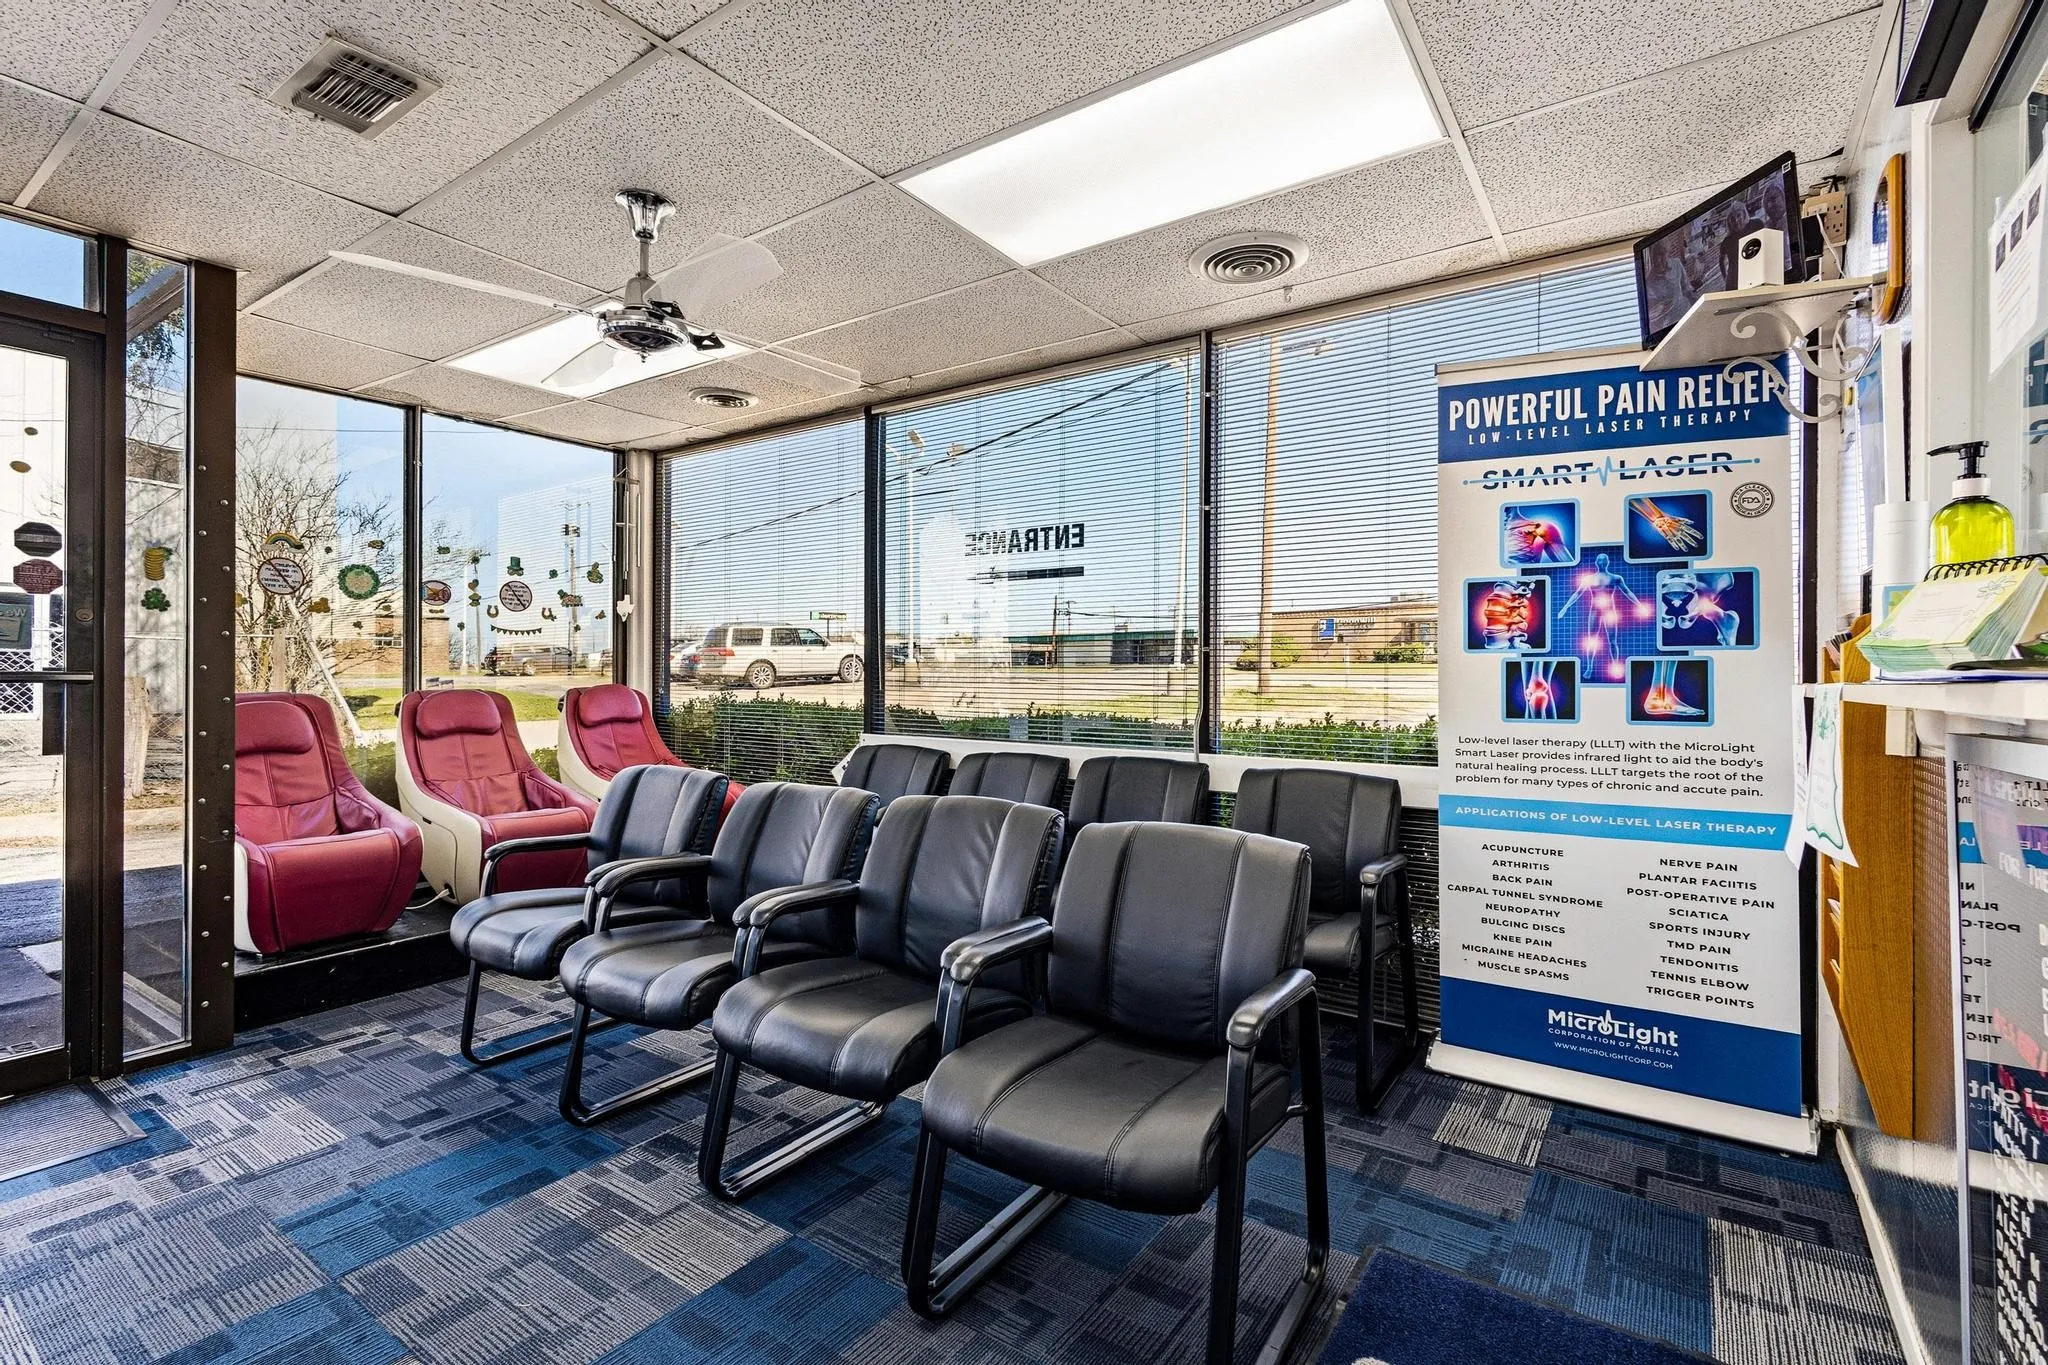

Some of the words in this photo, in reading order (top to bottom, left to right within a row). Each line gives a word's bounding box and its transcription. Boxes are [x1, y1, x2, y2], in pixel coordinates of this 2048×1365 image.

[1449, 387, 1588, 431] POWERFUL
[1598, 379, 1666, 417] PAIN
[1468, 425, 1570, 445] LOW-LEVEL
[1585, 418, 1644, 435] LASER
[1660, 409, 1751, 429] THERAPY
[1482, 462, 1594, 490] SMART
[1619, 452, 1734, 480] LASER
[1459, 736, 1509, 745] Low-level
[1513, 737, 1539, 746] laser
[1542, 738, 1587, 749] therapy
[1590, 739, 1625, 750] (LLLT)
[1629, 740, 1656, 750] with
[1660, 741, 1681, 751] the
[1685, 742, 1755, 754] MicroLight
[1455, 748, 1487, 757] Smart
[1490, 749, 1519, 758] Laser
[1522, 751, 1571, 760] provides
[1574, 752, 1621, 762] infrared
[1624, 754, 1652, 764] light
[1656, 756, 1669, 764] to
[1672, 756, 1691, 765] aid
[1695, 757, 1717, 766] the
[1721, 758, 1763, 769] body's
[1455, 761, 1493, 770] natural
[1496, 763, 1537, 774] healing
[1540, 766, 1587, 774] process.
[1591, 767, 1618, 776] LLLT
[1622, 768, 1666, 779] targets
[1669, 770, 1690, 779] the
[1694, 771, 1720, 780] root
[1724, 772, 1738, 781] of
[1741, 773, 1764, 782] the
[1455, 774, 1500, 783] problem
[1503, 775, 1519, 784] for
[1522, 778, 1554, 787] many
[1557, 779, 1589, 789] types
[1592, 780, 1604, 789] of
[1606, 781, 1652, 791] chronic
[1655, 784, 1679, 793] and
[1683, 786, 1727, 795] accute
[1730, 787, 1764, 797] pain.
[1455, 806, 1546, 820] APPLICATIONS
[1550, 812, 1568, 821] OF
[1572, 814, 1651, 827] LOW-LEVEL
[1656, 819, 1701, 830] LASER
[1706, 823, 1777, 835] THERAPY
[1482, 843, 1564, 857] ACUPUNCTURE
[1492, 859, 1550, 871] ARTHRITIS
[1659, 858, 1702, 869] NERVE
[1706, 862, 1738, 872] PAIN
[1492, 874, 1522, 884] BACK
[1525, 877, 1553, 887] PAIN
[1639, 872, 1697, 885] PLANTAR
[1702, 878, 1758, 890] FACIITIS
[1447, 883, 1489, 895] CARPAL
[1492, 888, 1535, 900] TUNNEL
[1538, 893, 1604, 908] SYNDROME
[1626, 887, 1737, 906] POST-OPERATIVE
[1742, 898, 1775, 909] PAIN
[1486, 902, 1561, 918] NEUROPATHY
[1668, 907, 1729, 921] SCIATICA
[1481, 917, 1529, 930] BULGING
[1532, 923, 1566, 934] DISCS
[1649, 921, 1698, 934] SPORTS
[1702, 928, 1751, 941] INJURY
[1493, 933, 1522, 943] KNEE
[1525, 937, 1552, 947] PAIN
[1667, 939, 1695, 950] TMD
[1699, 944, 1731, 955] PAIN
[1461, 943, 1514, 958] MIGRAINE
[1518, 951, 1587, 968] HEADACHES
[1660, 955, 1739, 972] TENDONITIS
[1477, 960, 1521, 973] MUSCLE
[1524, 967, 1570, 981] SPASMS
[1650, 970, 1697, 984] TENNIS
[1700, 977, 1750, 991] ELBOW
[1646, 986, 1701, 1001] TRIGGER
[1705, 995, 1755, 1009] POINTS
[1548, 1009, 1679, 1047] MicroLight
[1548, 1027, 1616, 1046] CORPORATION
[1634, 1045, 1680, 1057] AMERICA
[1554, 1041, 1673, 1069] WWW.MICROLIGHTCORP.COM
